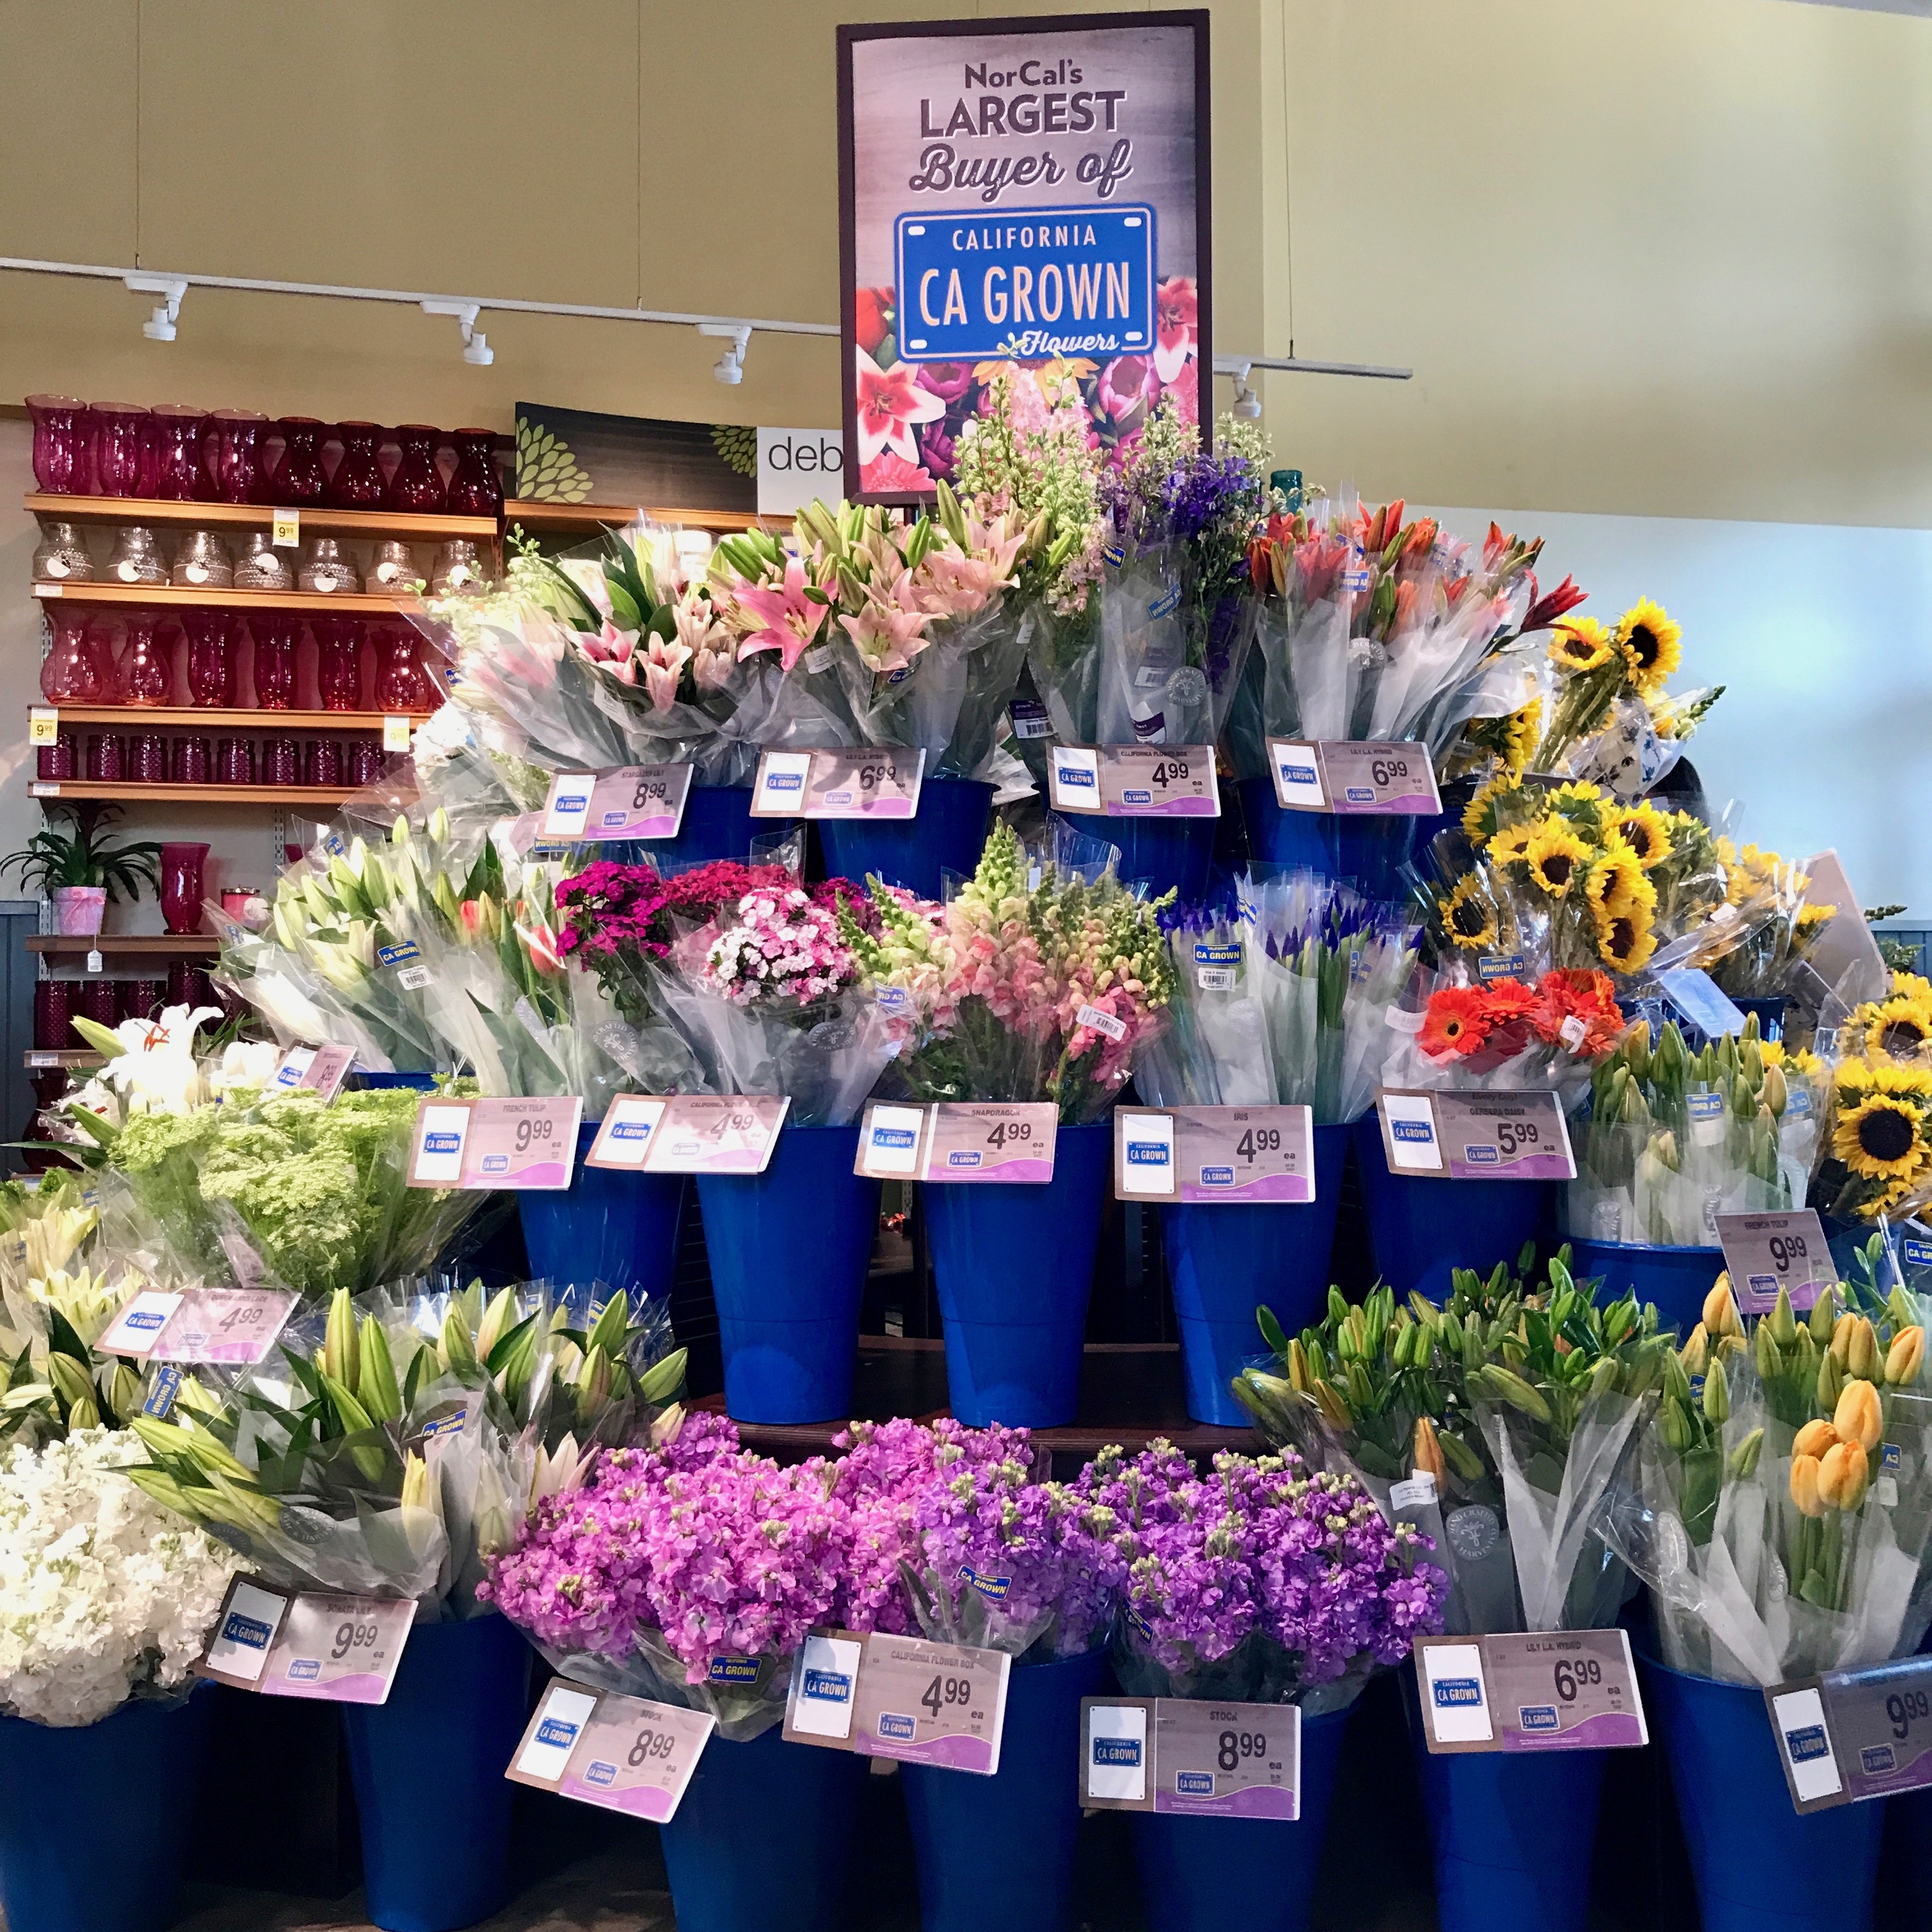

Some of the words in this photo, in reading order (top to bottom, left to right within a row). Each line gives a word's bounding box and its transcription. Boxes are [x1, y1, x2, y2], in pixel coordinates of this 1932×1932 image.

[965, 59, 1083, 89] NorCal's
[921, 91, 1127, 139] LARGEST
[909, 142, 1066, 203] Buyer
[1076, 139, 1133, 200] of
[953, 225, 1096, 251] CALIFORNIA
[920, 268, 969, 326] CA
[984, 262, 1129, 324] GROWN
[1020, 330, 1119, 356] Flowers
[769, 436, 843, 472] deb
[859, 765, 896, 790] 699
[1061, 773, 1070, 781] CA
[1070, 774, 1092, 783] GROWN
[1152, 762, 1189, 788] 499
[1293, 772, 1314, 781] GROWN
[1372, 760, 1407, 786] 699
[565, 801, 585, 809] GROWN
[394, 947, 418, 957] GROWN
[1234, 1113, 1248, 1121] IRIS
[515, 1119, 553, 1152] 999
[613, 1128, 622, 1136] CA
[623, 1128, 647, 1137] GROWN
[887, 1136, 912, 1145] GROWN
[986, 1123, 1032, 1150] 499
[1395, 1128, 1404, 1137] CA
[1406, 1128, 1429, 1138] GROWN
[1497, 1123, 1538, 1154] 599
[427, 1140, 435, 1149] CA
[436, 1140, 458, 1149] GROWN
[1236, 1128, 1280, 1163] 499
[1130, 1150, 1140, 1160] CA
[1141, 1150, 1166, 1160] GROWN
[1908, 1248, 1920, 1257] CA
[137, 1318, 160, 1327] GROWN
[436, 1418, 464, 1434] GROWN
[961, 1571, 972, 1582] CA
[974, 1580, 1006, 1594] GROWN
[228, 1623, 237, 1634] CA
[238, 1626, 266, 1643] GROWN
[331, 1622, 378, 1659] 999
[891, 1650, 930, 1664] CALIFORNIA
[931, 1655, 958, 1666] FLOWER
[960, 1659, 975, 1669] BOX
[711, 1665, 724, 1675] CA
[725, 1665, 756, 1676] GROWN
[807, 1680, 818, 1692] CA
[819, 1682, 847, 1697] GROWN
[1554, 1659, 1601, 1701] 699
[921, 1675, 971, 1717] 499
[1438, 1689, 1448, 1701] CA
[1449, 1688, 1477, 1701] GROWN
[971, 1710, 984, 1719] ea
[1209, 1711, 1238, 1722] STOCK
[540, 1727, 549, 1737] CA
[550, 1730, 572, 1744] GROWN
[882, 1722, 890, 1731] CA
[891, 1724, 911, 1735] GROWN
[628, 1729, 675, 1767] 899
[1098, 1747, 1107, 1759] CA
[1109, 1748, 1137, 1761] GROWN
[1218, 1730, 1266, 1771] 899
[1269, 1761, 1282, 1770] ea
[1180, 1779, 1188, 1788] CA
[1188, 1780, 1210, 1789] GROWN
